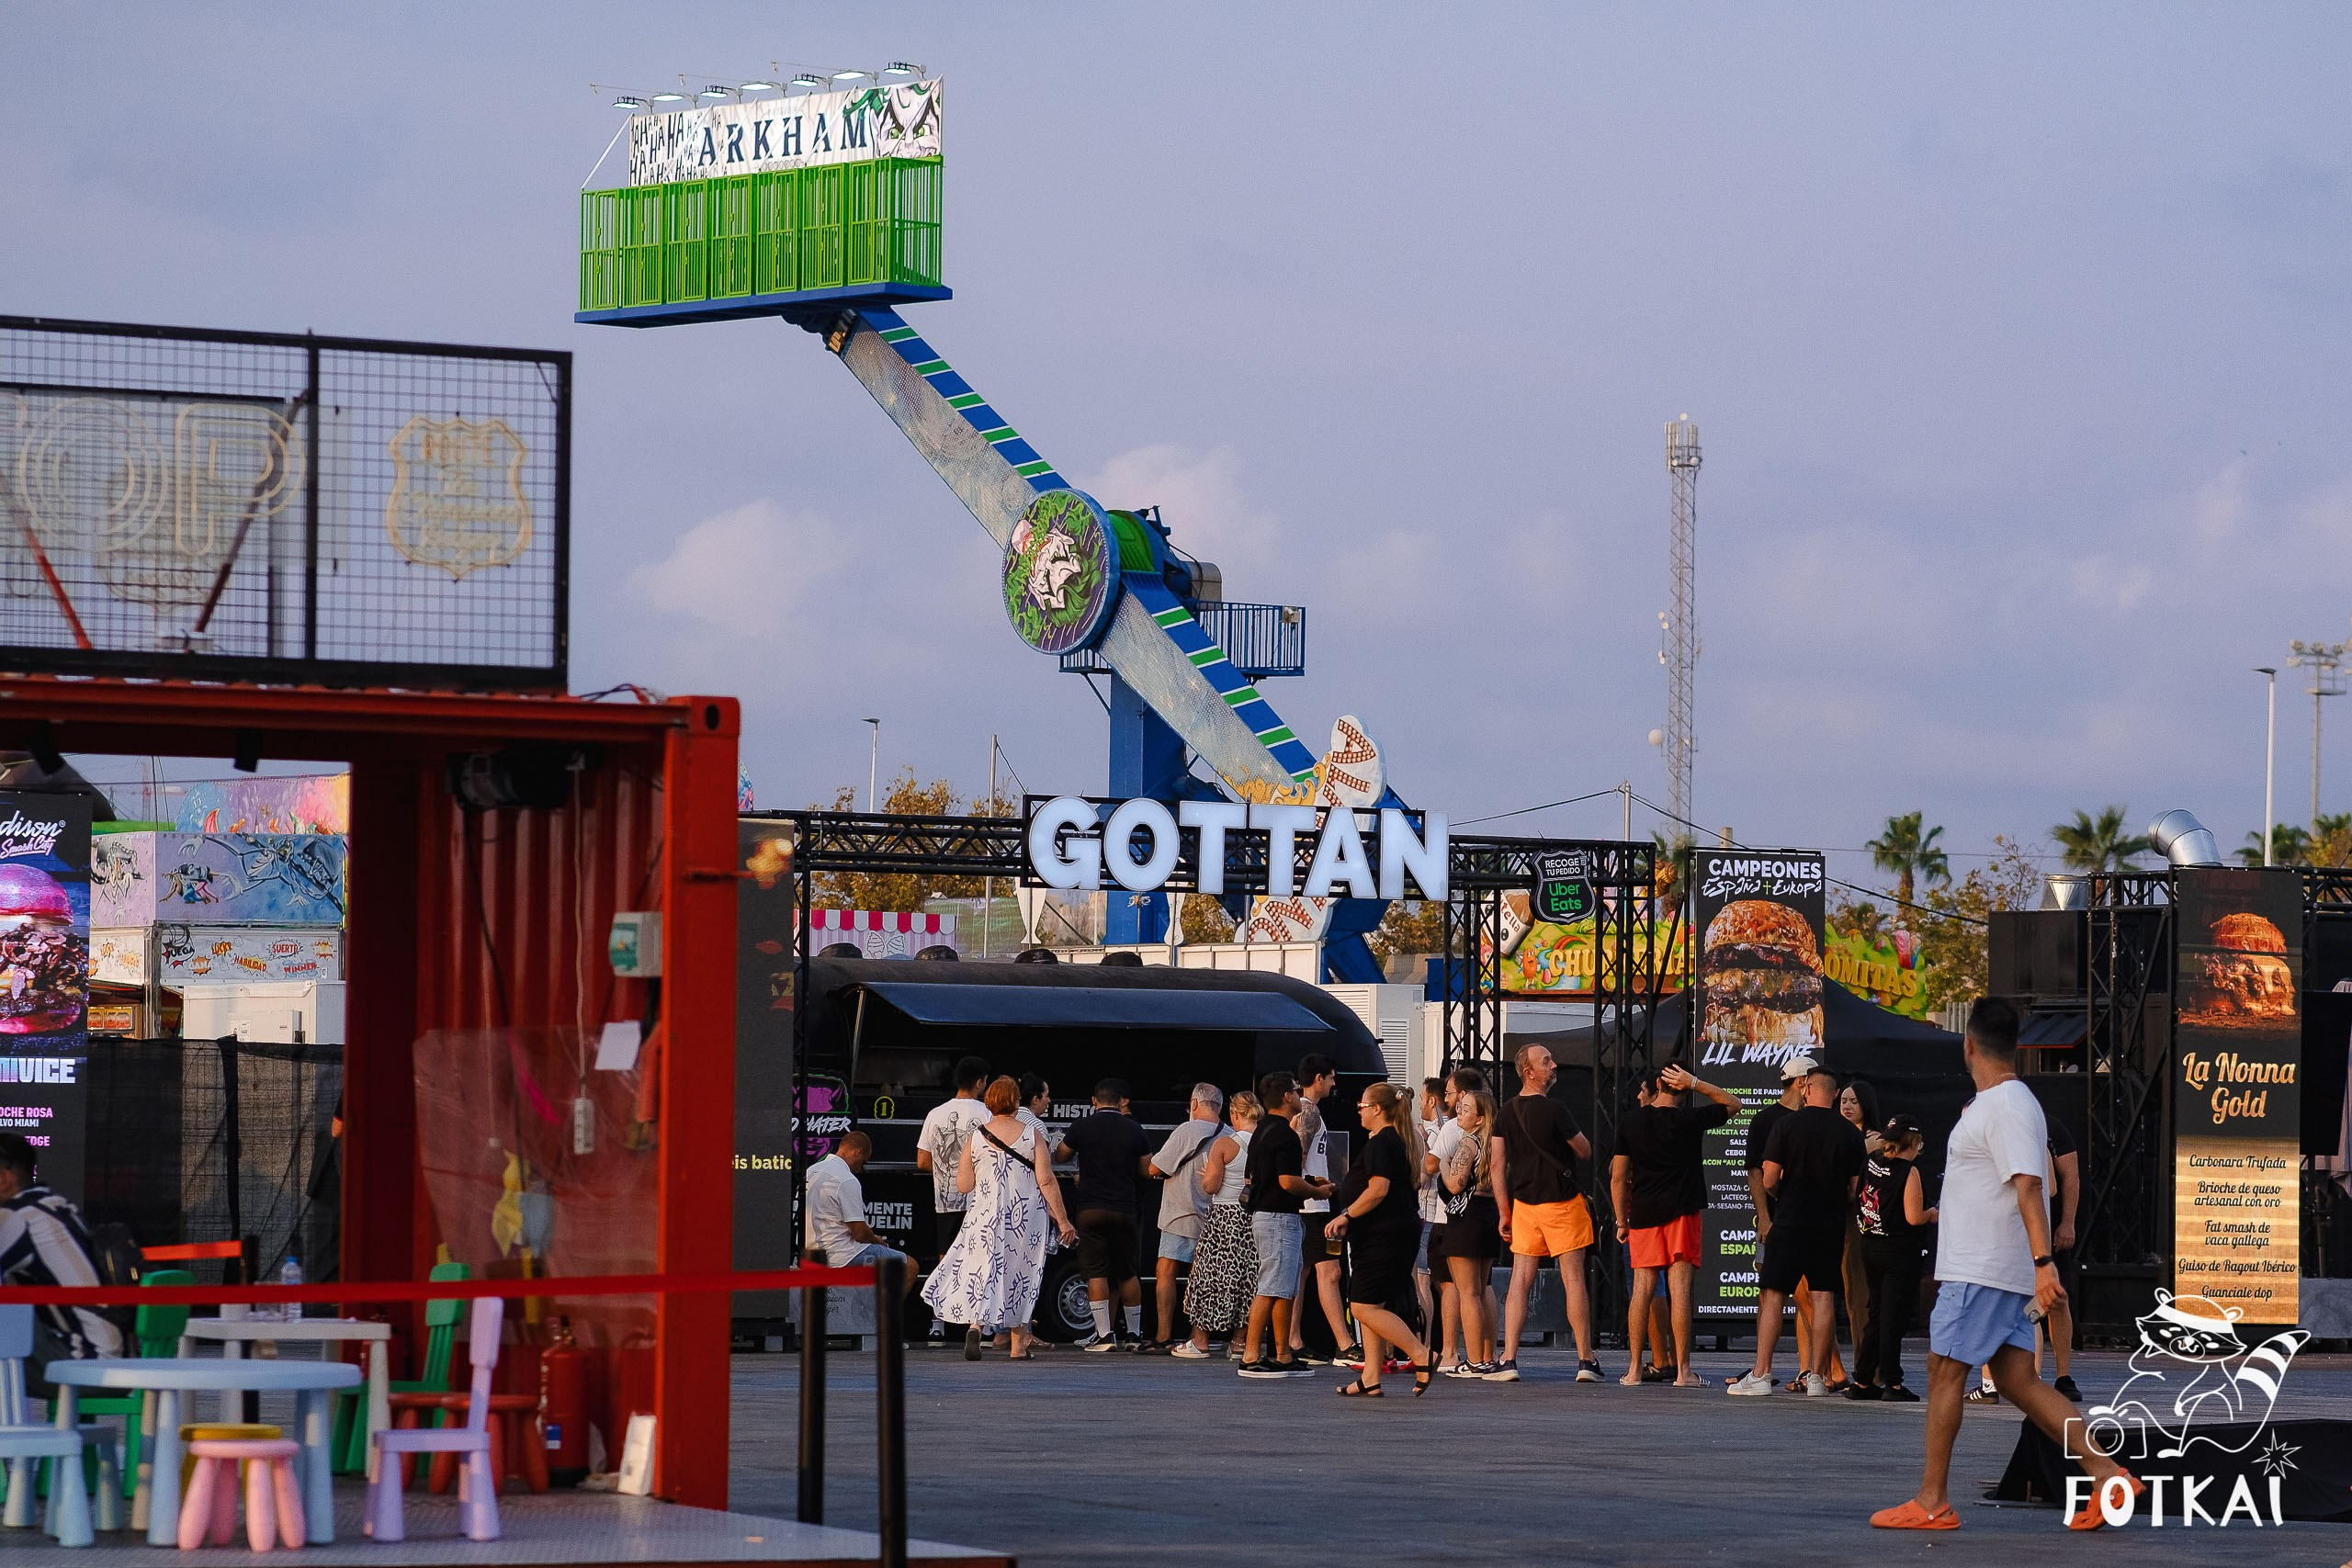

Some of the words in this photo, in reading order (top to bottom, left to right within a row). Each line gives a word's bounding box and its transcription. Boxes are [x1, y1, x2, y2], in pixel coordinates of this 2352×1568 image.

[697, 107, 868, 168] ARKHAM
[1029, 795, 1449, 902] GOTTAN
[1544, 858, 1579, 869] RECOGE
[1555, 867, 1580, 875] PEDIDO
[1709, 859, 1822, 879] CAMPEONES
[1548, 883, 1580, 897] Uber
[1550, 897, 1582, 912] Eats
[284, 962, 317, 974] WINNER
[1825, 953, 1917, 998] OMITAS
[1702, 1040, 1736, 1067] LIL
[2182, 1052, 2211, 1091] La
[2215, 1052, 2296, 1084] Nonna
[26, 1107, 53, 1118] ROSA
[2211, 1087, 2267, 1124] Gold
[15, 1118, 40, 1127] MIAMI
[2189, 1154, 2244, 1168] Carbonara
[2245, 1155, 2287, 1172] Trufada
[2198, 1180, 2236, 1194] Brioche
[2238, 1182, 2251, 1194] de
[2252, 1185, 2282, 1198] queso
[2194, 1195, 2243, 1207] artesanal
[2245, 1198, 2262, 1207] con
[2265, 1198, 2282, 1207] oro
[2204, 1220, 2222, 1233] Fat
[2223, 1222, 2256, 1234] smash
[2258, 1222, 2271, 1234] de
[2205, 1236, 2229, 1246] vaca
[2231, 1235, 2270, 1249] gallega
[2178, 1258, 2208, 1275] Guiso
[2209, 1260, 2222, 1272] de
[2223, 1258, 2260, 1276] Ragout
[2261, 1259, 2297, 1273] Ibérico
[2201, 1284, 2252, 1301] Guanciale
[2254, 1285, 2273, 1303] dop
[1698, 1305, 1758, 1314] DIRECTAMENTE
